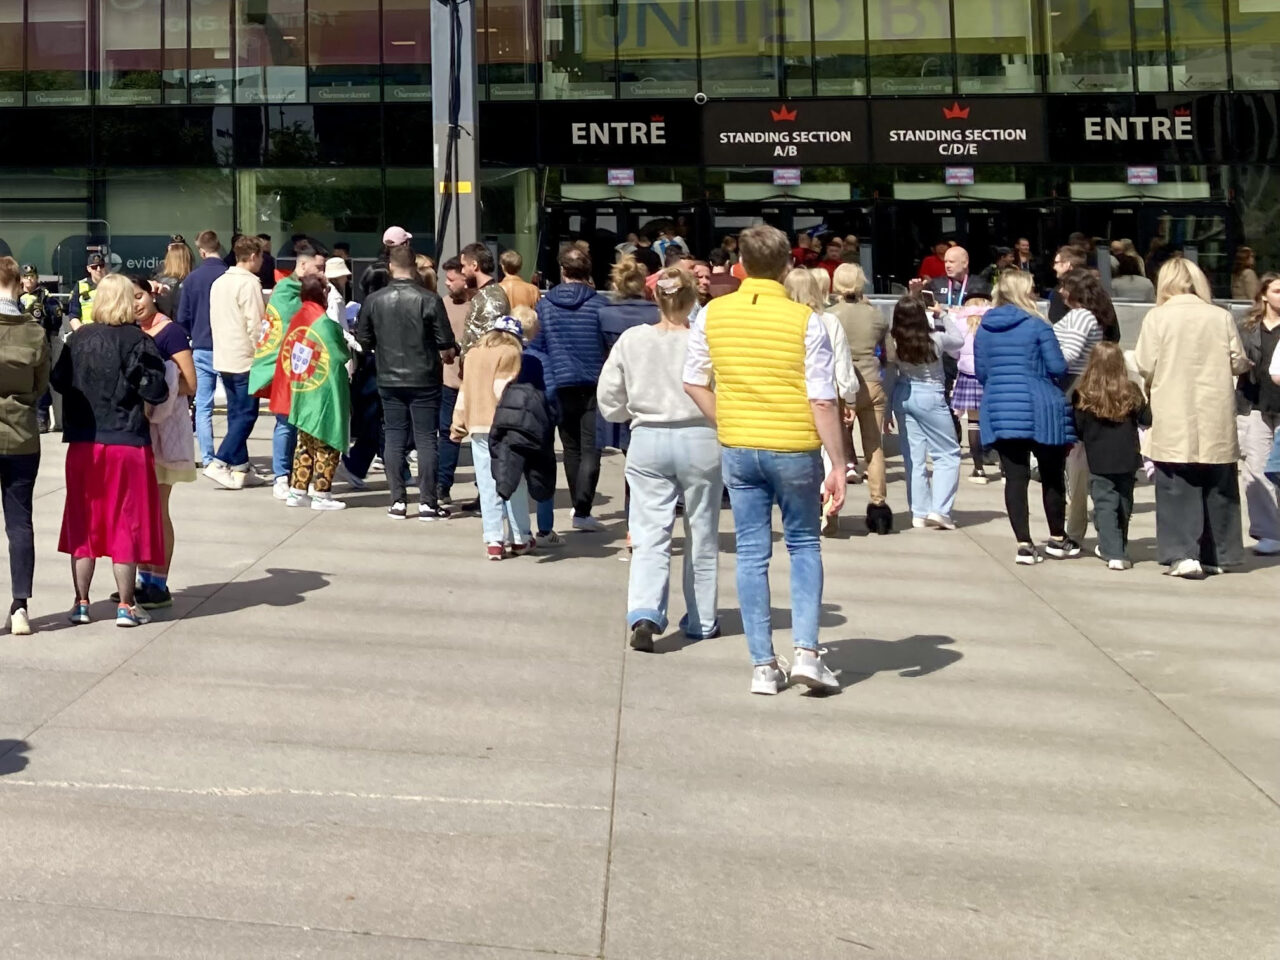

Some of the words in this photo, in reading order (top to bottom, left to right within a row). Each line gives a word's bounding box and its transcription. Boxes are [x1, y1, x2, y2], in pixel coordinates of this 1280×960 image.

[720, 131, 789, 143] STANDING
[792, 130, 851, 143] SECTION
[889, 129, 962, 142] STANDING
[965, 128, 1027, 141] SECTION
[774, 145, 798, 157] A/B
[939, 144, 978, 156] C/D/E
